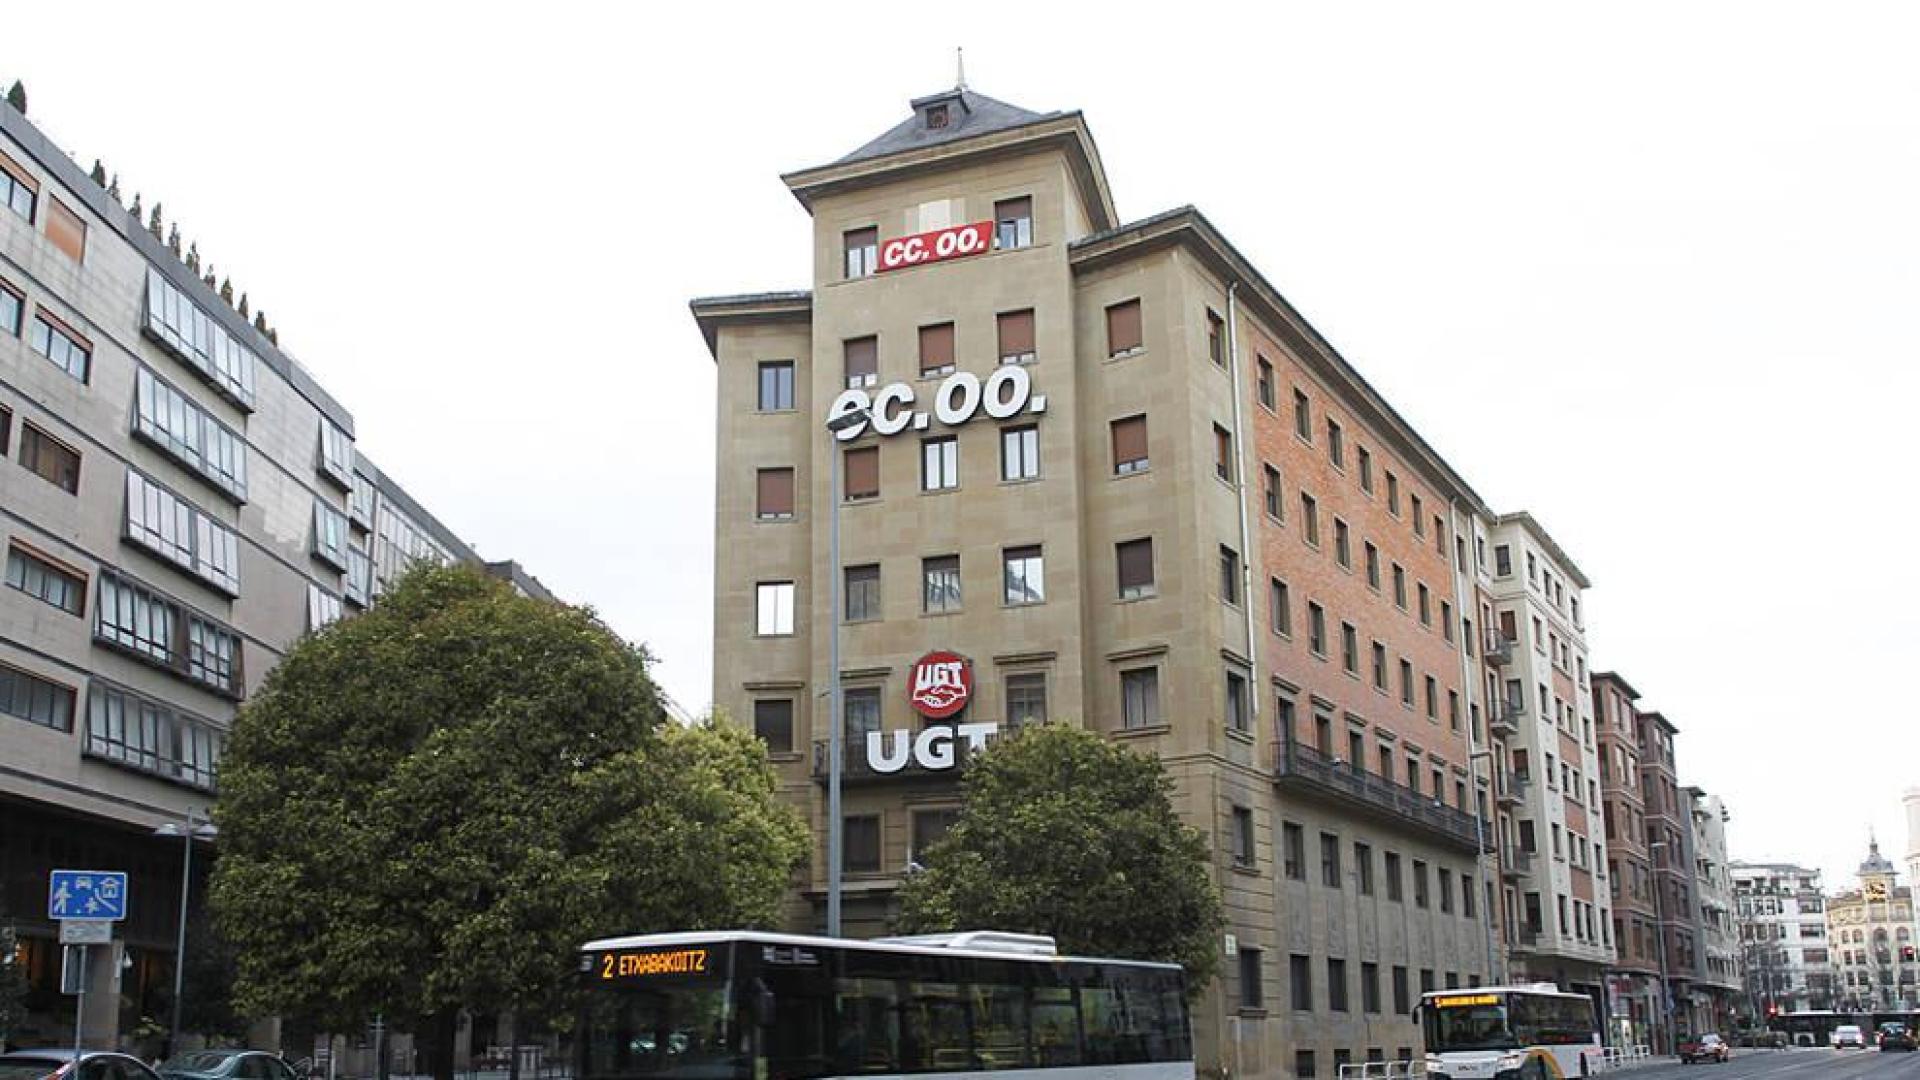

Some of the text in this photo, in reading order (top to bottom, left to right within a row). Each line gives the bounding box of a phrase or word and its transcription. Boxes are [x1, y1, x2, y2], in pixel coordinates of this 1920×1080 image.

[914, 662, 963, 691] UGT
[867, 722, 998, 772] UGT
[603, 949, 705, 978] 2 ETXABAKOITZ
